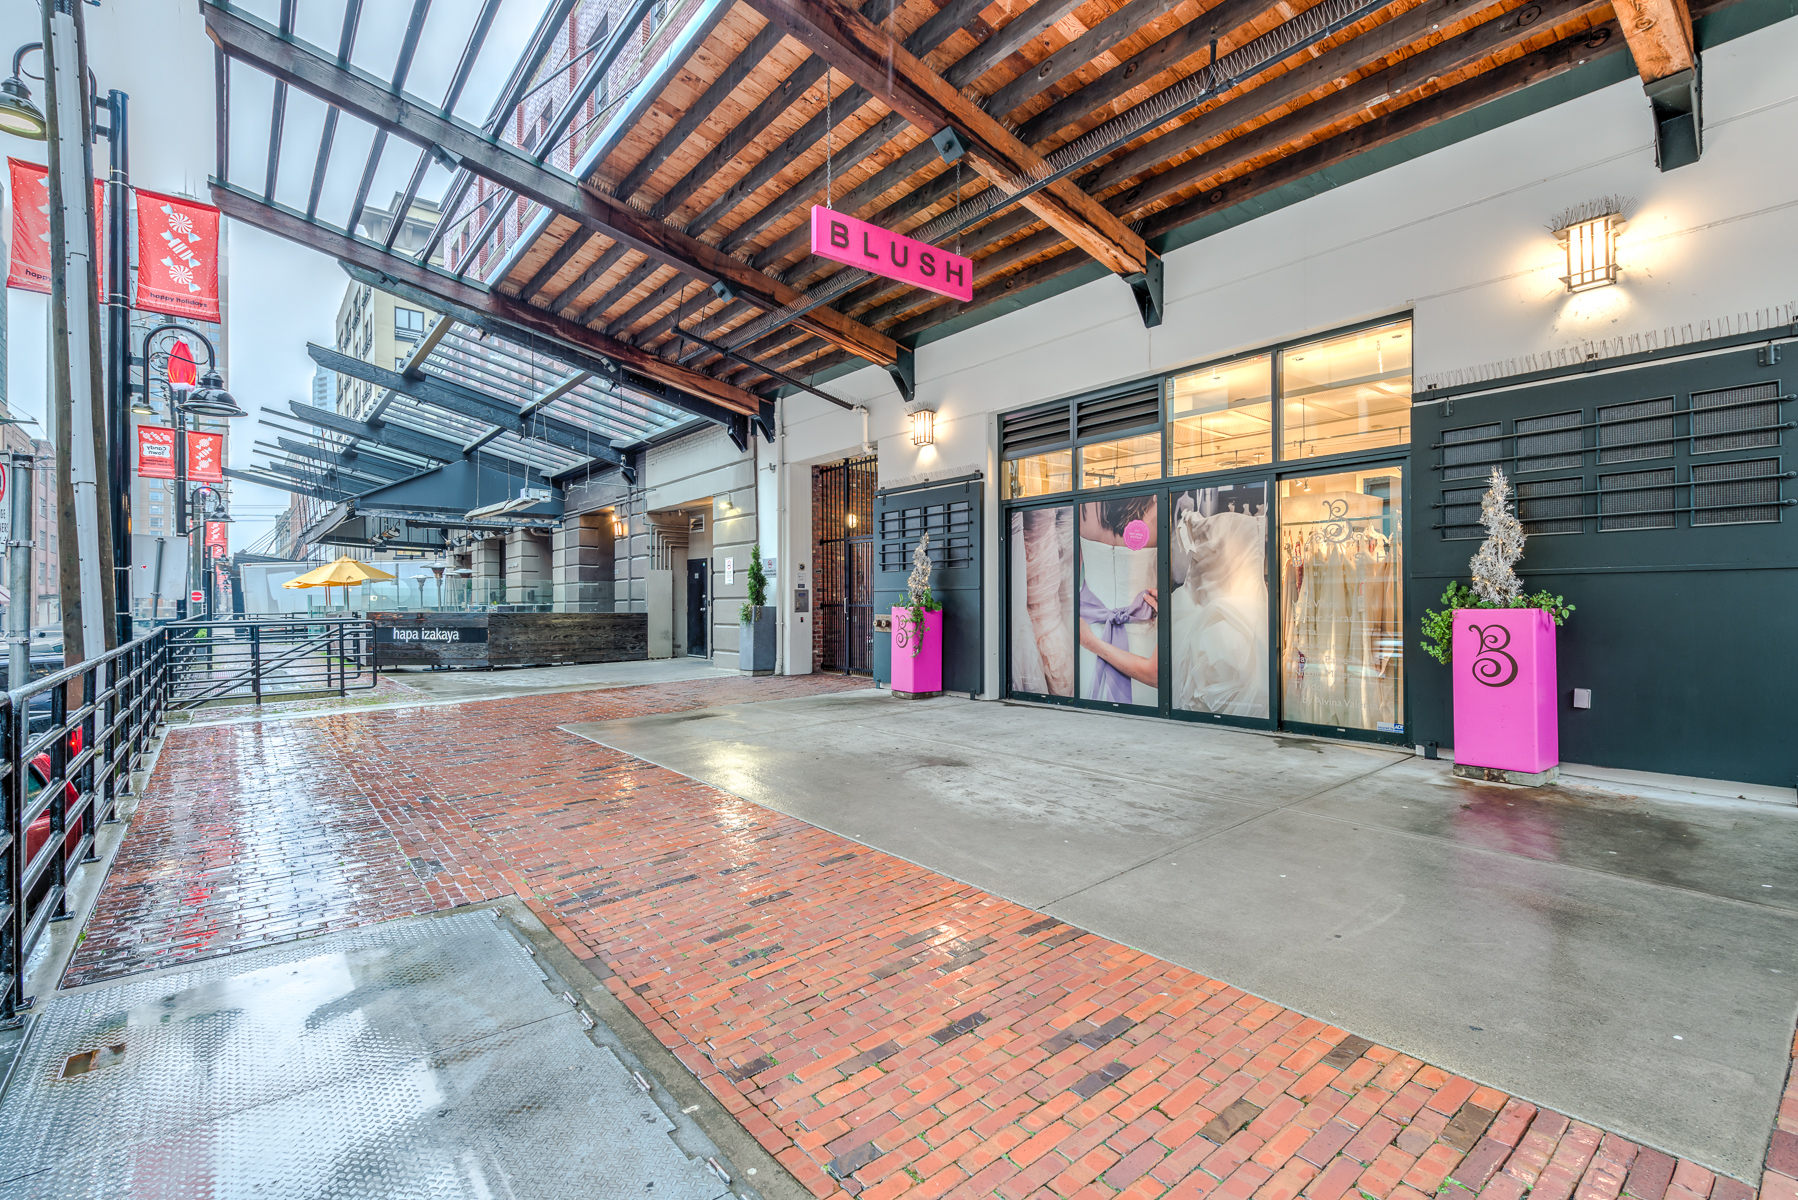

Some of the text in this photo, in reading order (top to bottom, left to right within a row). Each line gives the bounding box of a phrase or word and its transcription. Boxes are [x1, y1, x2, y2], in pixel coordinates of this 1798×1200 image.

[830, 220, 964, 287] BLUSH
[25, 268, 52, 282] happy
[150, 292, 208, 308] happy holidays
[393, 627, 460, 644] hapa izakaya
[1302, 695, 1313, 706] by
[1314, 696, 1342, 707] Alvina
